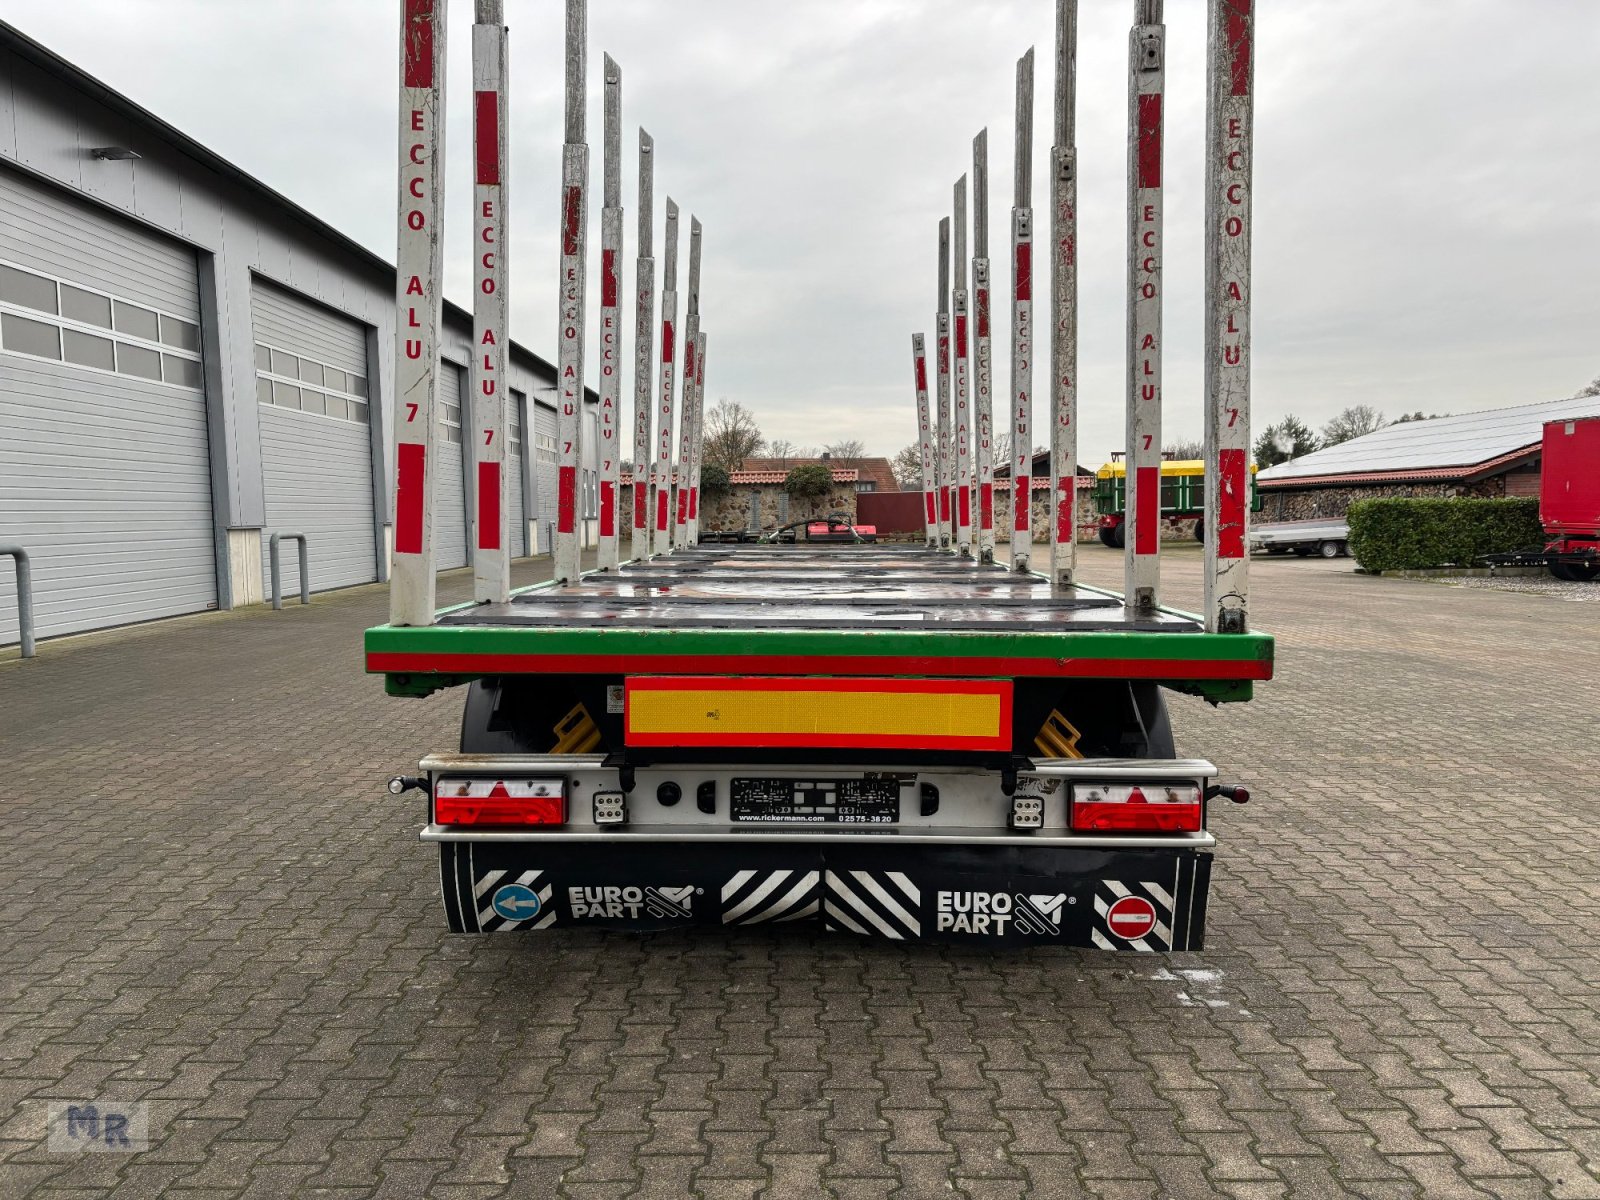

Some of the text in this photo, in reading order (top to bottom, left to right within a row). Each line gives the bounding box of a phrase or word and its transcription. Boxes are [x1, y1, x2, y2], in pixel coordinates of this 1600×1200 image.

[406, 110, 425, 422] ECCO ALU 7
[1225, 118, 1243, 427] ECCO ALU 7
[481, 201, 496, 446] ECCO ALU 7
[1142, 205, 1156, 451] ECCO ALU 7
[563, 268, 576, 454] ECCO ALU 7
[603, 317, 613, 471] ECCO ALU 7
[958, 365, 966, 409] ECCO
[1018, 391, 1028, 434] ALU
[637, 411, 646, 447] ALU
[661, 370, 671, 483] ECCO ALU 7
[981, 413, 989, 449] ALU
[923, 443, 931, 468] ALU
[1018, 455, 1026, 466] 7
[639, 464, 644, 474] 7
[942, 472, 947, 480] 7
[961, 470, 966, 479] 7
[983, 466, 989, 475] 7
[926, 479, 931, 487] 7
[738, 814, 825, 822] www.rickermann.com
[568, 886, 644, 904] EURO
[937, 890, 1012, 913] EURO
[570, 902, 640, 919] PART
[937, 912, 1012, 936] PART
